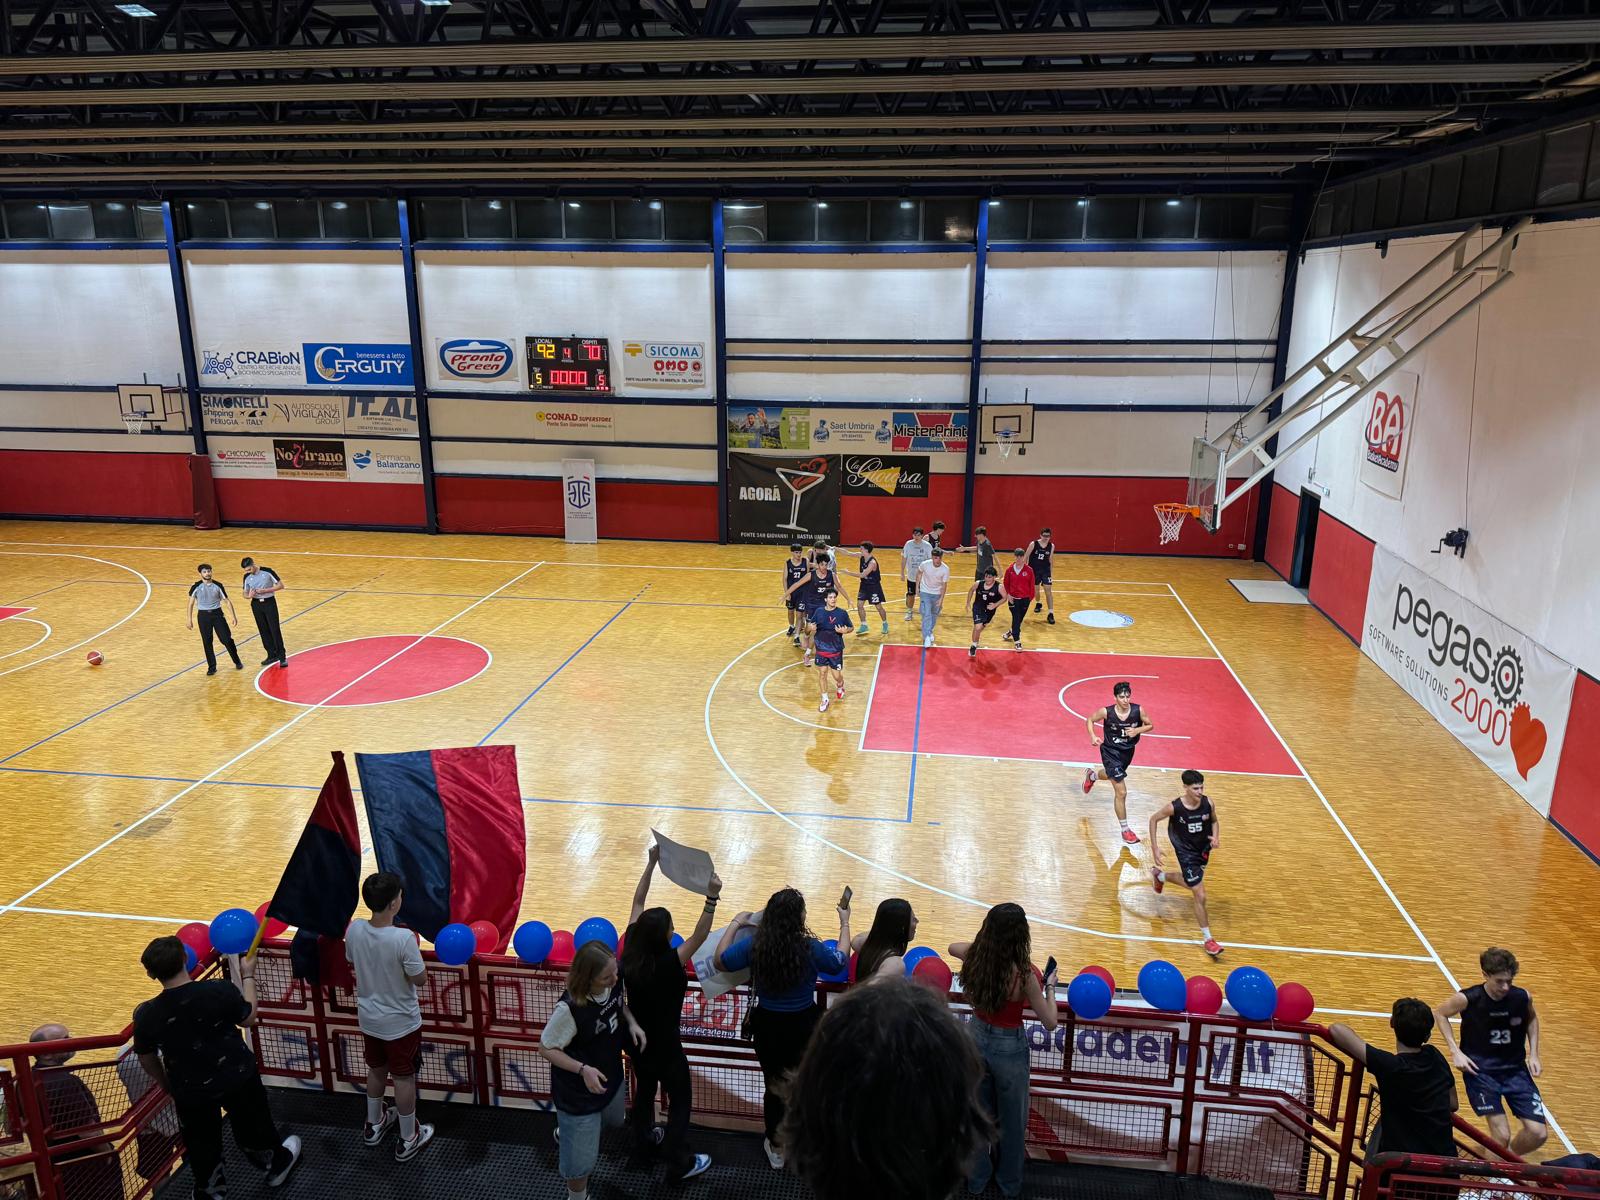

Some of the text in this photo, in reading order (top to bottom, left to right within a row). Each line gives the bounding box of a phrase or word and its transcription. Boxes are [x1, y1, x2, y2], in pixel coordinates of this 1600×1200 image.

[537, 344, 555, 359] 92
[563, 348, 571, 359] 4
[583, 345, 601, 360] 70
[650, 346, 699, 357] SICOMA
[236, 351, 301, 365] CRABioN
[314, 346, 405, 381] CERGUTY
[451, 353, 505, 365] pronto
[457, 362, 501, 371] Green
[535, 373, 542, 384] 5
[598, 375, 605, 386] 5
[202, 396, 269, 408] SIMONELLI
[203, 408, 233, 418] shipping
[291, 409, 340, 419] VIGILANZI
[545, 413, 578, 421] CONAD
[848, 422, 875, 430] Umbria
[893, 424, 968, 437] MisterPrint
[1369, 392, 1403, 461] BA
[1037, 553, 1045, 561] 12
[1393, 583, 1524, 709] pegaso
[1369, 624, 1449, 701] SOFTWARE SOLUTIONS
[1451, 678, 1507, 746] 2000
[1188, 822, 1203, 834] 55
[1490, 1029, 1511, 1044] 23
